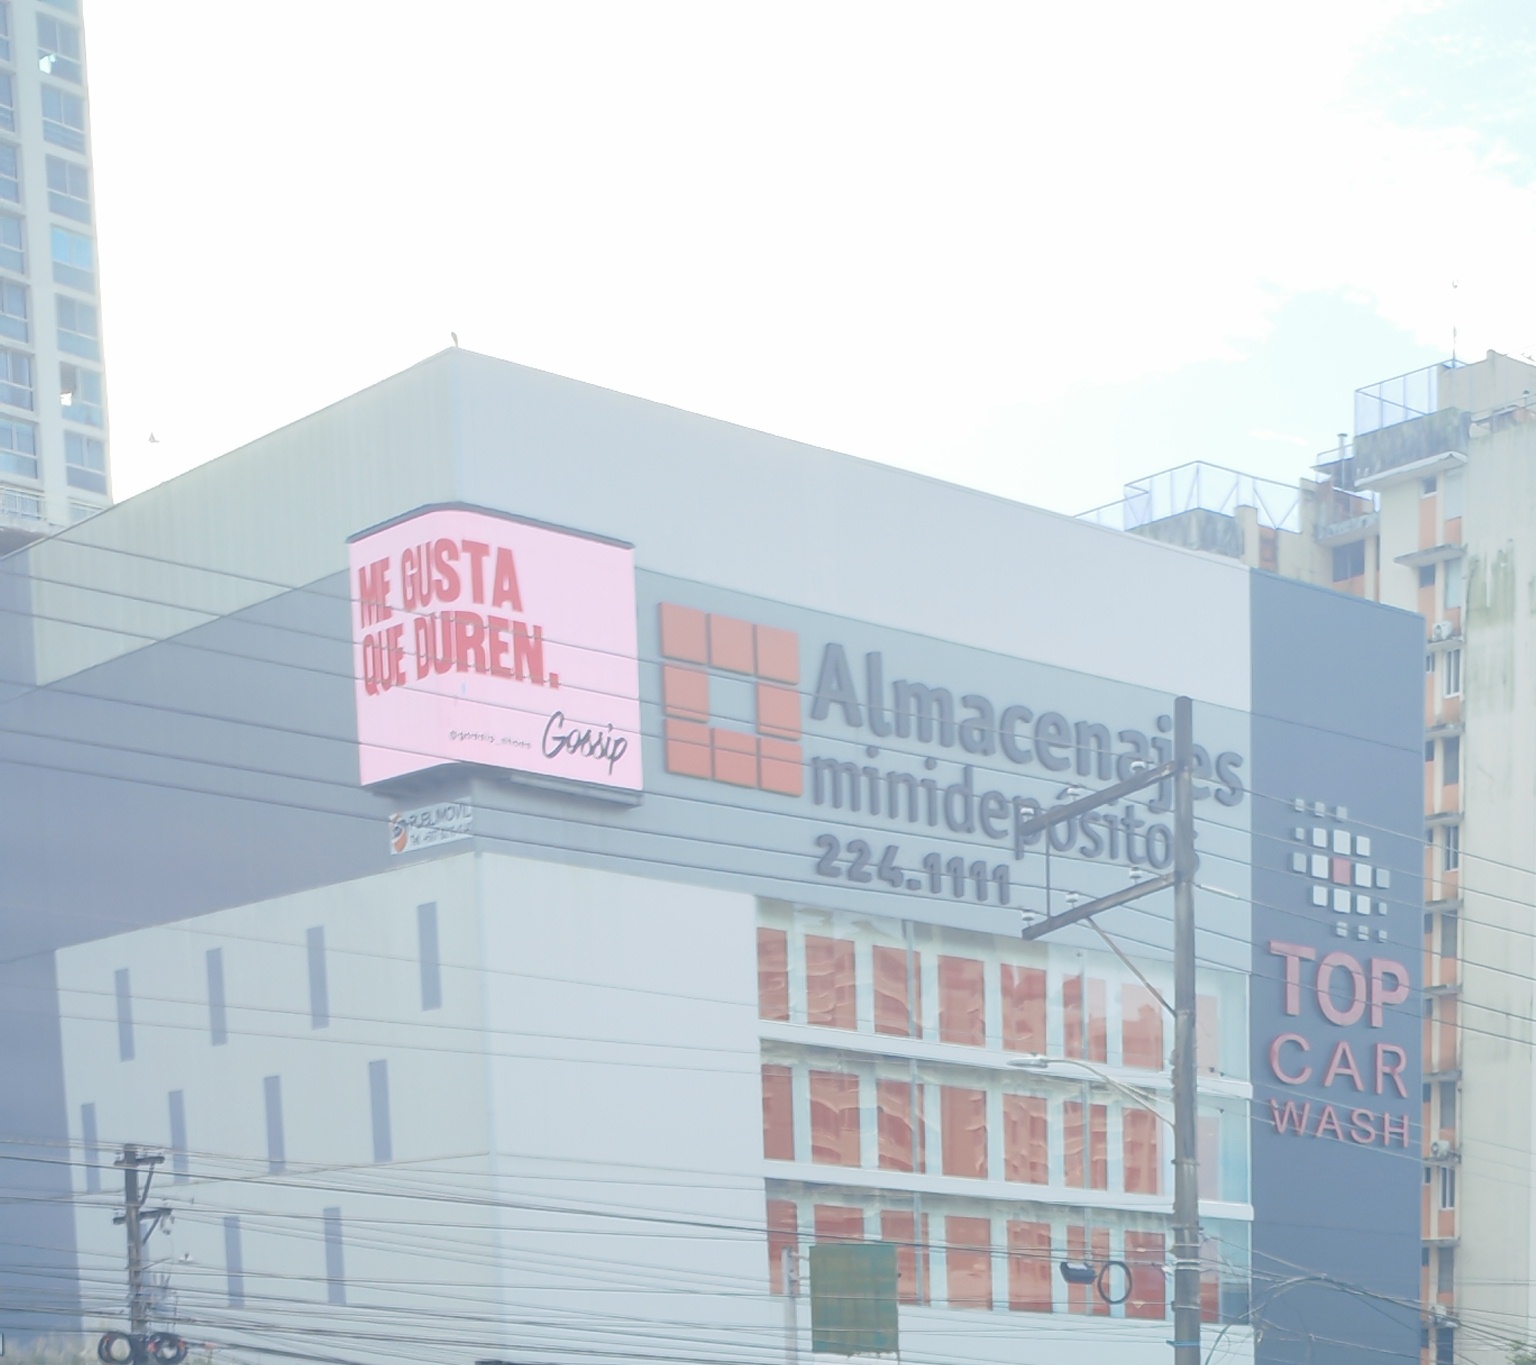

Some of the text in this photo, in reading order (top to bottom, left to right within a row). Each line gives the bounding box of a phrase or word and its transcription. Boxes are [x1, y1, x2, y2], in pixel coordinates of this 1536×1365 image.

[359, 538, 523, 629] ME GUSTA
[363, 610, 559, 696] QUE DUREN.
[542, 711, 628, 776] Gossip
[811, 642, 1244, 807] Almacenajes
[811, 747, 1198, 871] minidepósito
[815, 834, 1010, 905] 224.1111
[1270, 939, 1410, 1028] TOP
[1269, 1032, 1408, 1098] CAR
[1270, 1097, 1410, 1148] WASH
